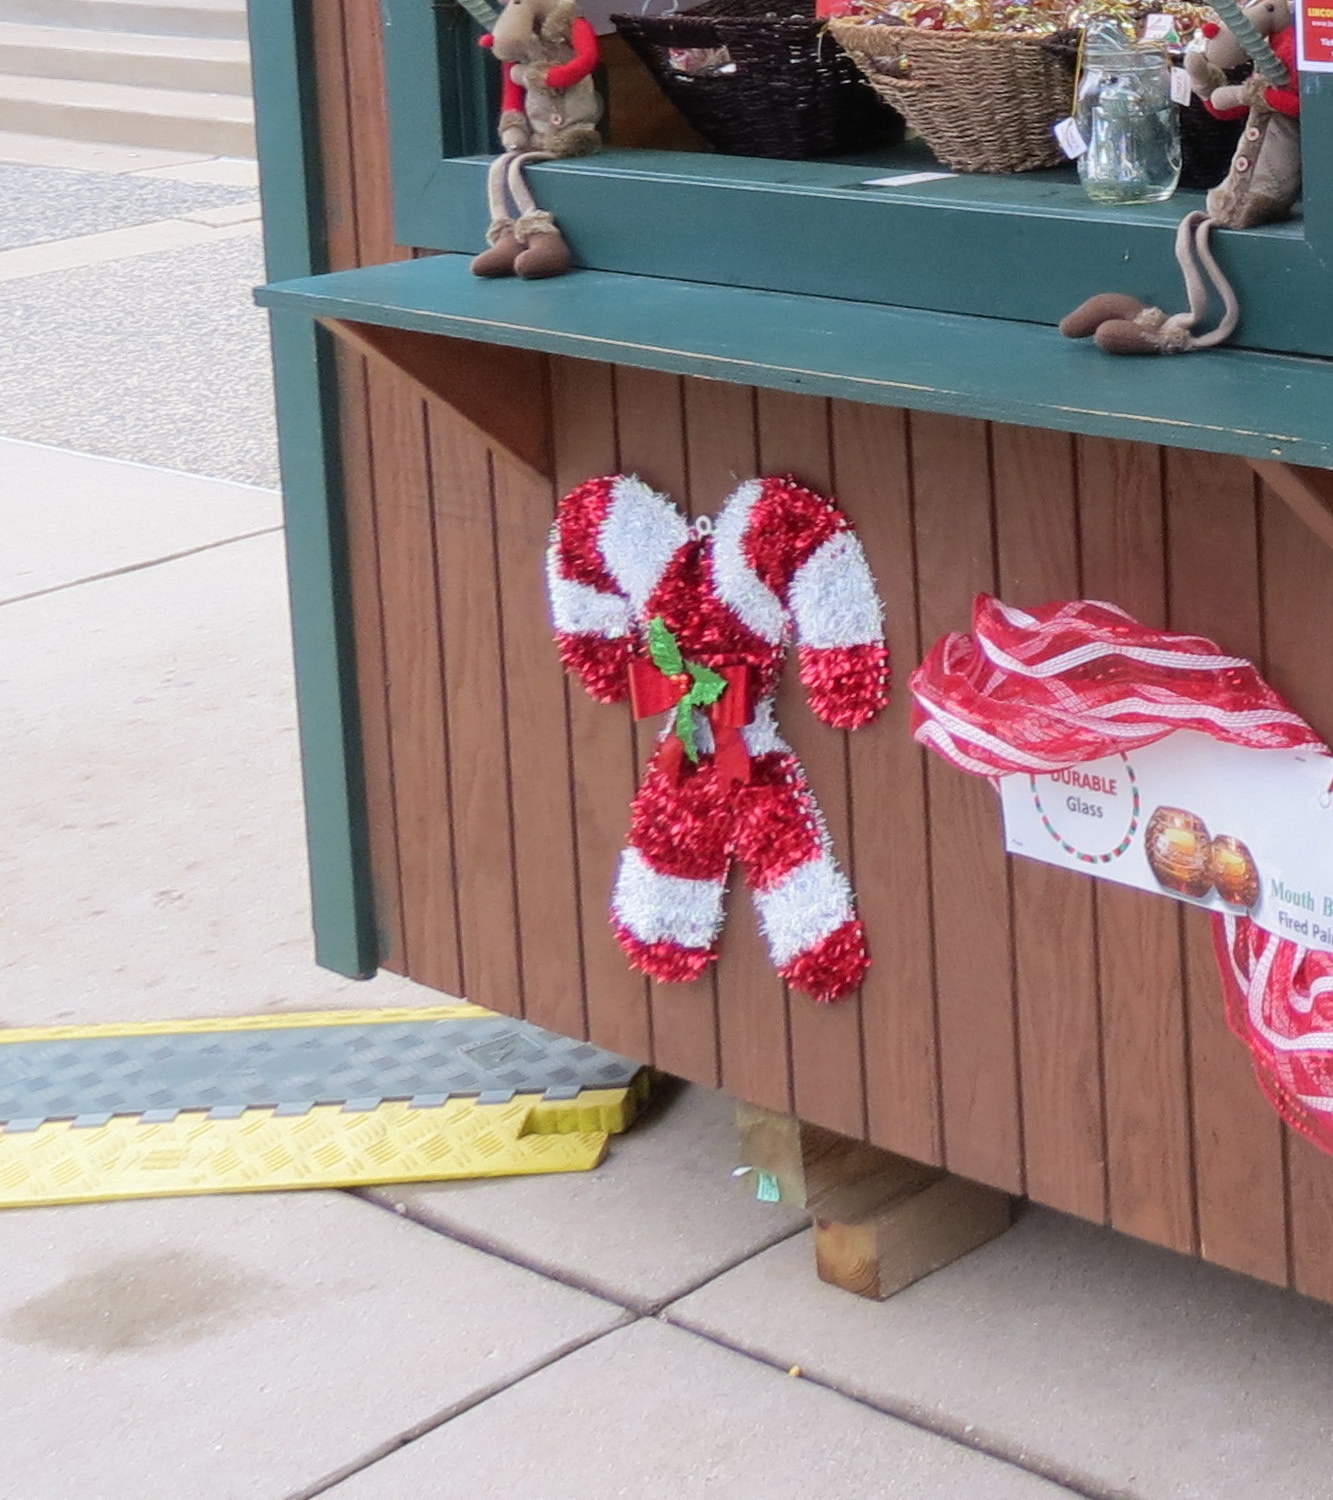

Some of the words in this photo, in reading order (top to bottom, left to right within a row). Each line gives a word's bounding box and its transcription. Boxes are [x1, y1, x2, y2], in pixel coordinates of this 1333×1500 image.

[1051, 769, 1118, 796] DURABLE
[1066, 795, 1104, 818] Glass
[1270, 878, 1316, 912] Mouth
[1278, 910, 1309, 936] Fired
